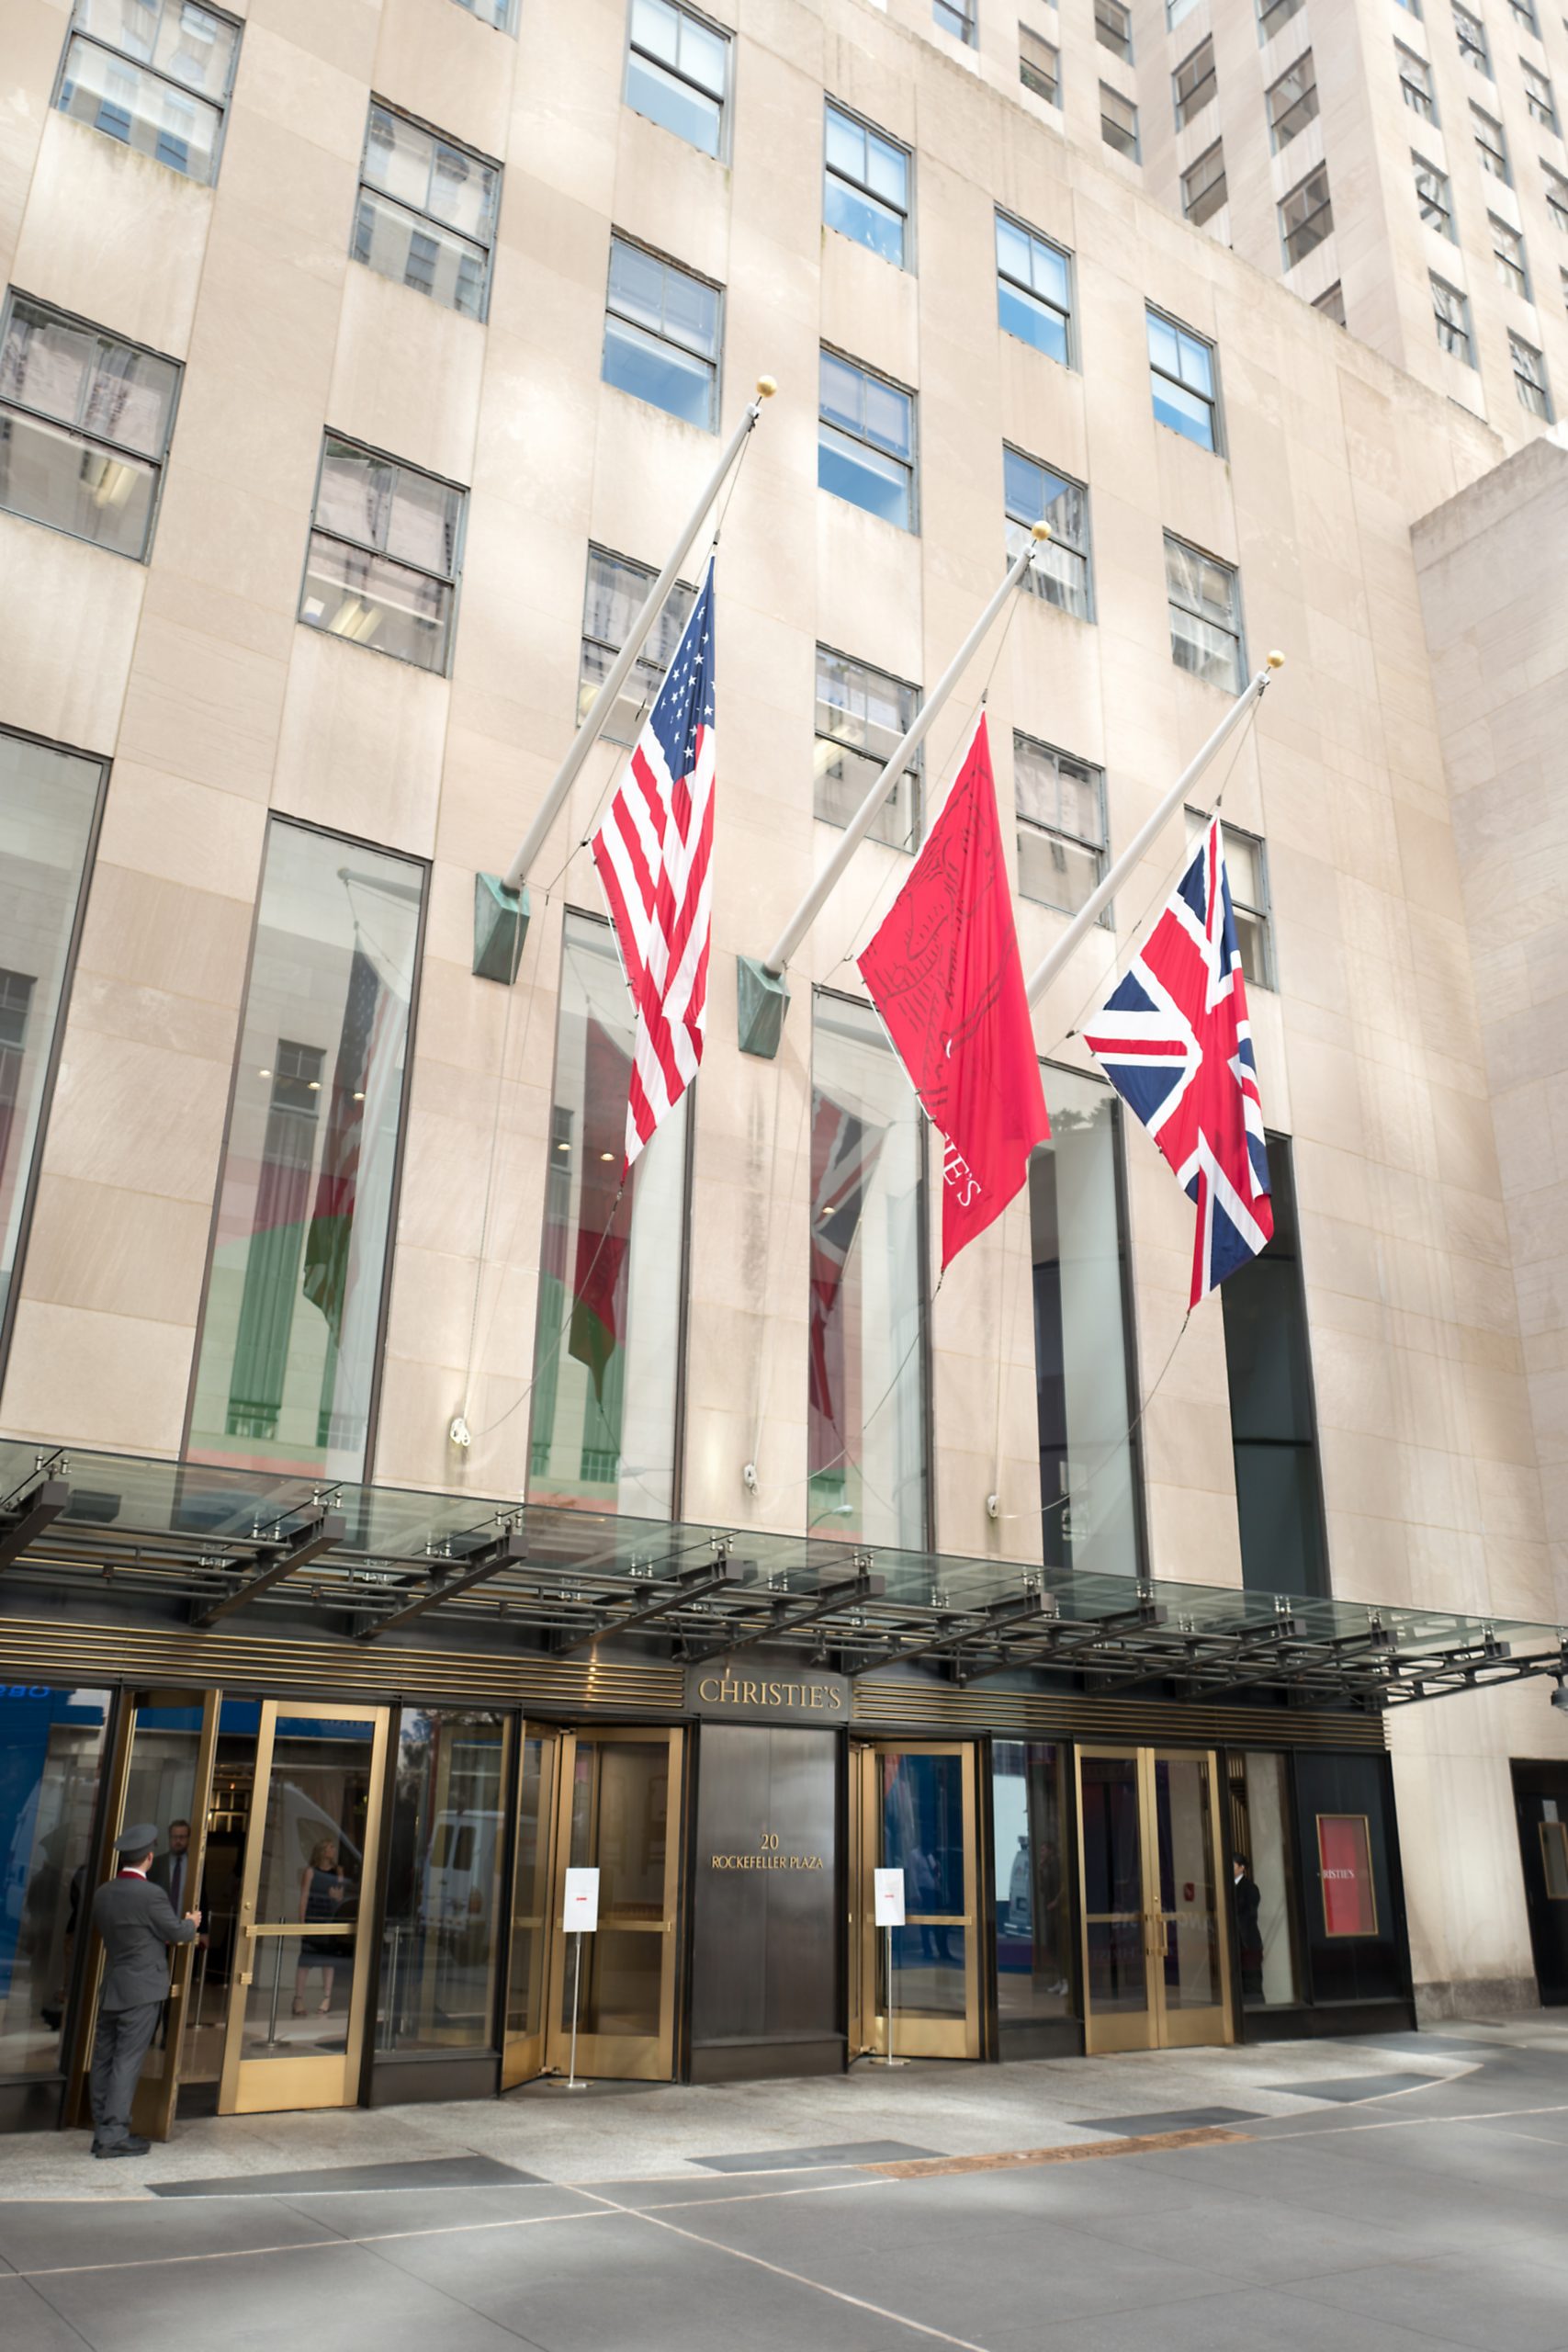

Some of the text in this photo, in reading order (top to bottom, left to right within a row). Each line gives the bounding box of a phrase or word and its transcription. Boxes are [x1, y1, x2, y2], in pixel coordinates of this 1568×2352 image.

[699, 1678, 841, 1710] CHRISTIE'S
[761, 1833, 779, 1850] 20
[711, 1855, 824, 1870] ROCKEFELLER PLAZA
